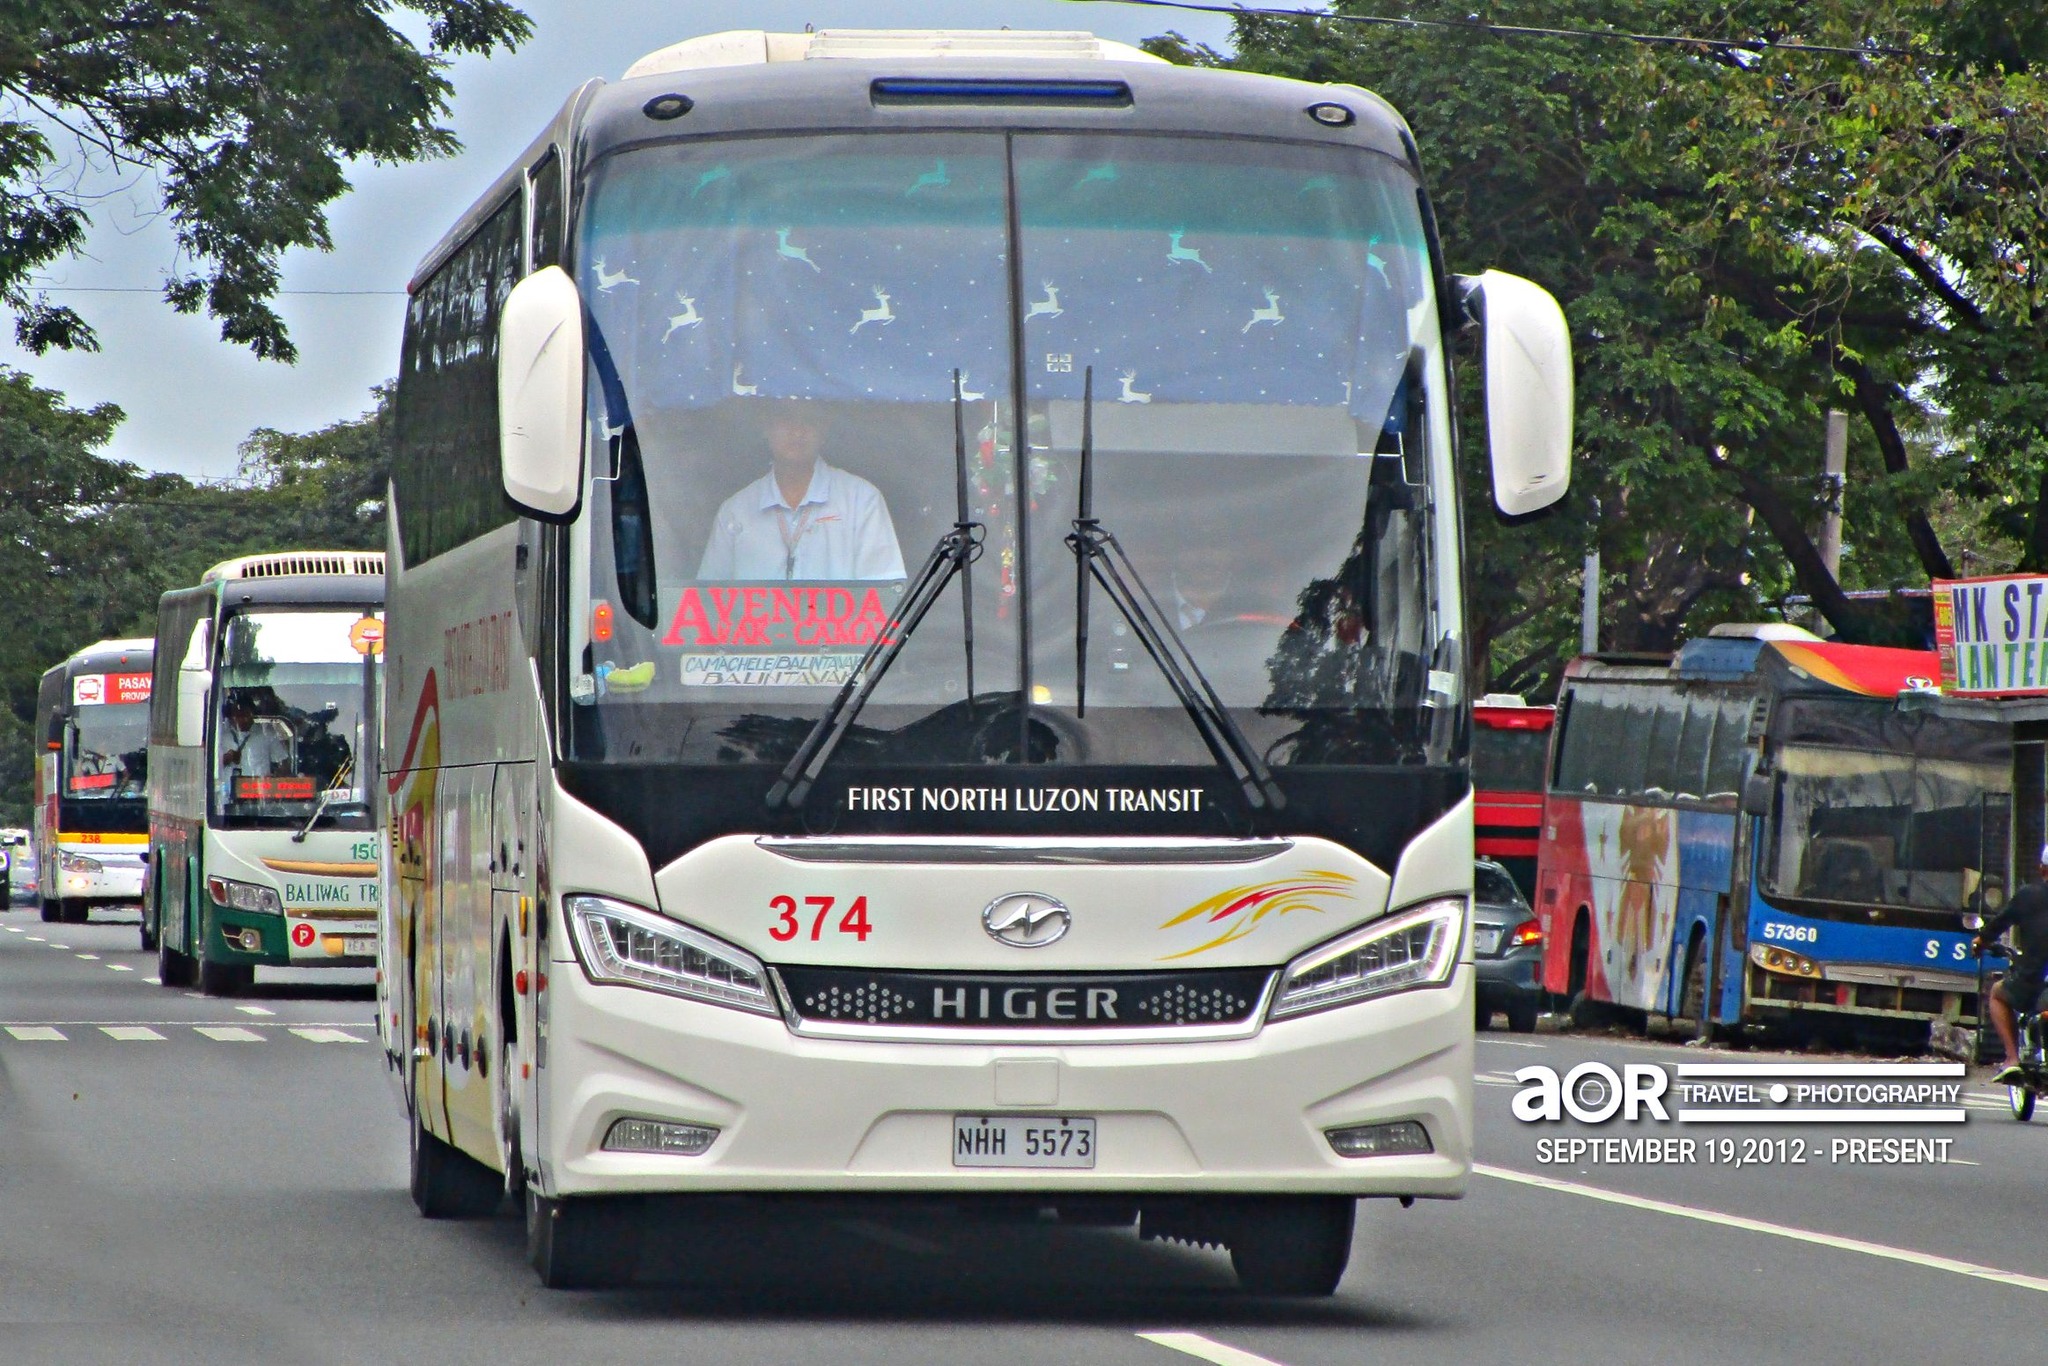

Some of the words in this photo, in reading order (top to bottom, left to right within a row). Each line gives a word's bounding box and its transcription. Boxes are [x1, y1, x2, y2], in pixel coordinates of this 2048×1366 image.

[661, 587, 888, 646] AVENIDA
[1953, 587, 1988, 642] MK
[2003, 583, 2048, 641] ST
[118, 677, 151, 690] PASAY
[848, 787, 915, 811] FIRST
[922, 787, 1007, 811] NORTH
[1015, 788, 1099, 812] LUZON
[1105, 788, 1205, 812] TRANSIT
[81, 834, 101, 844] 238
[286, 883, 349, 903] BALIWAG
[768, 894, 873, 942] 374
[932, 988, 1119, 1020] HIGER
[957, 1128, 1006, 1156] NHH
[1026, 1129, 1090, 1157] 5573
